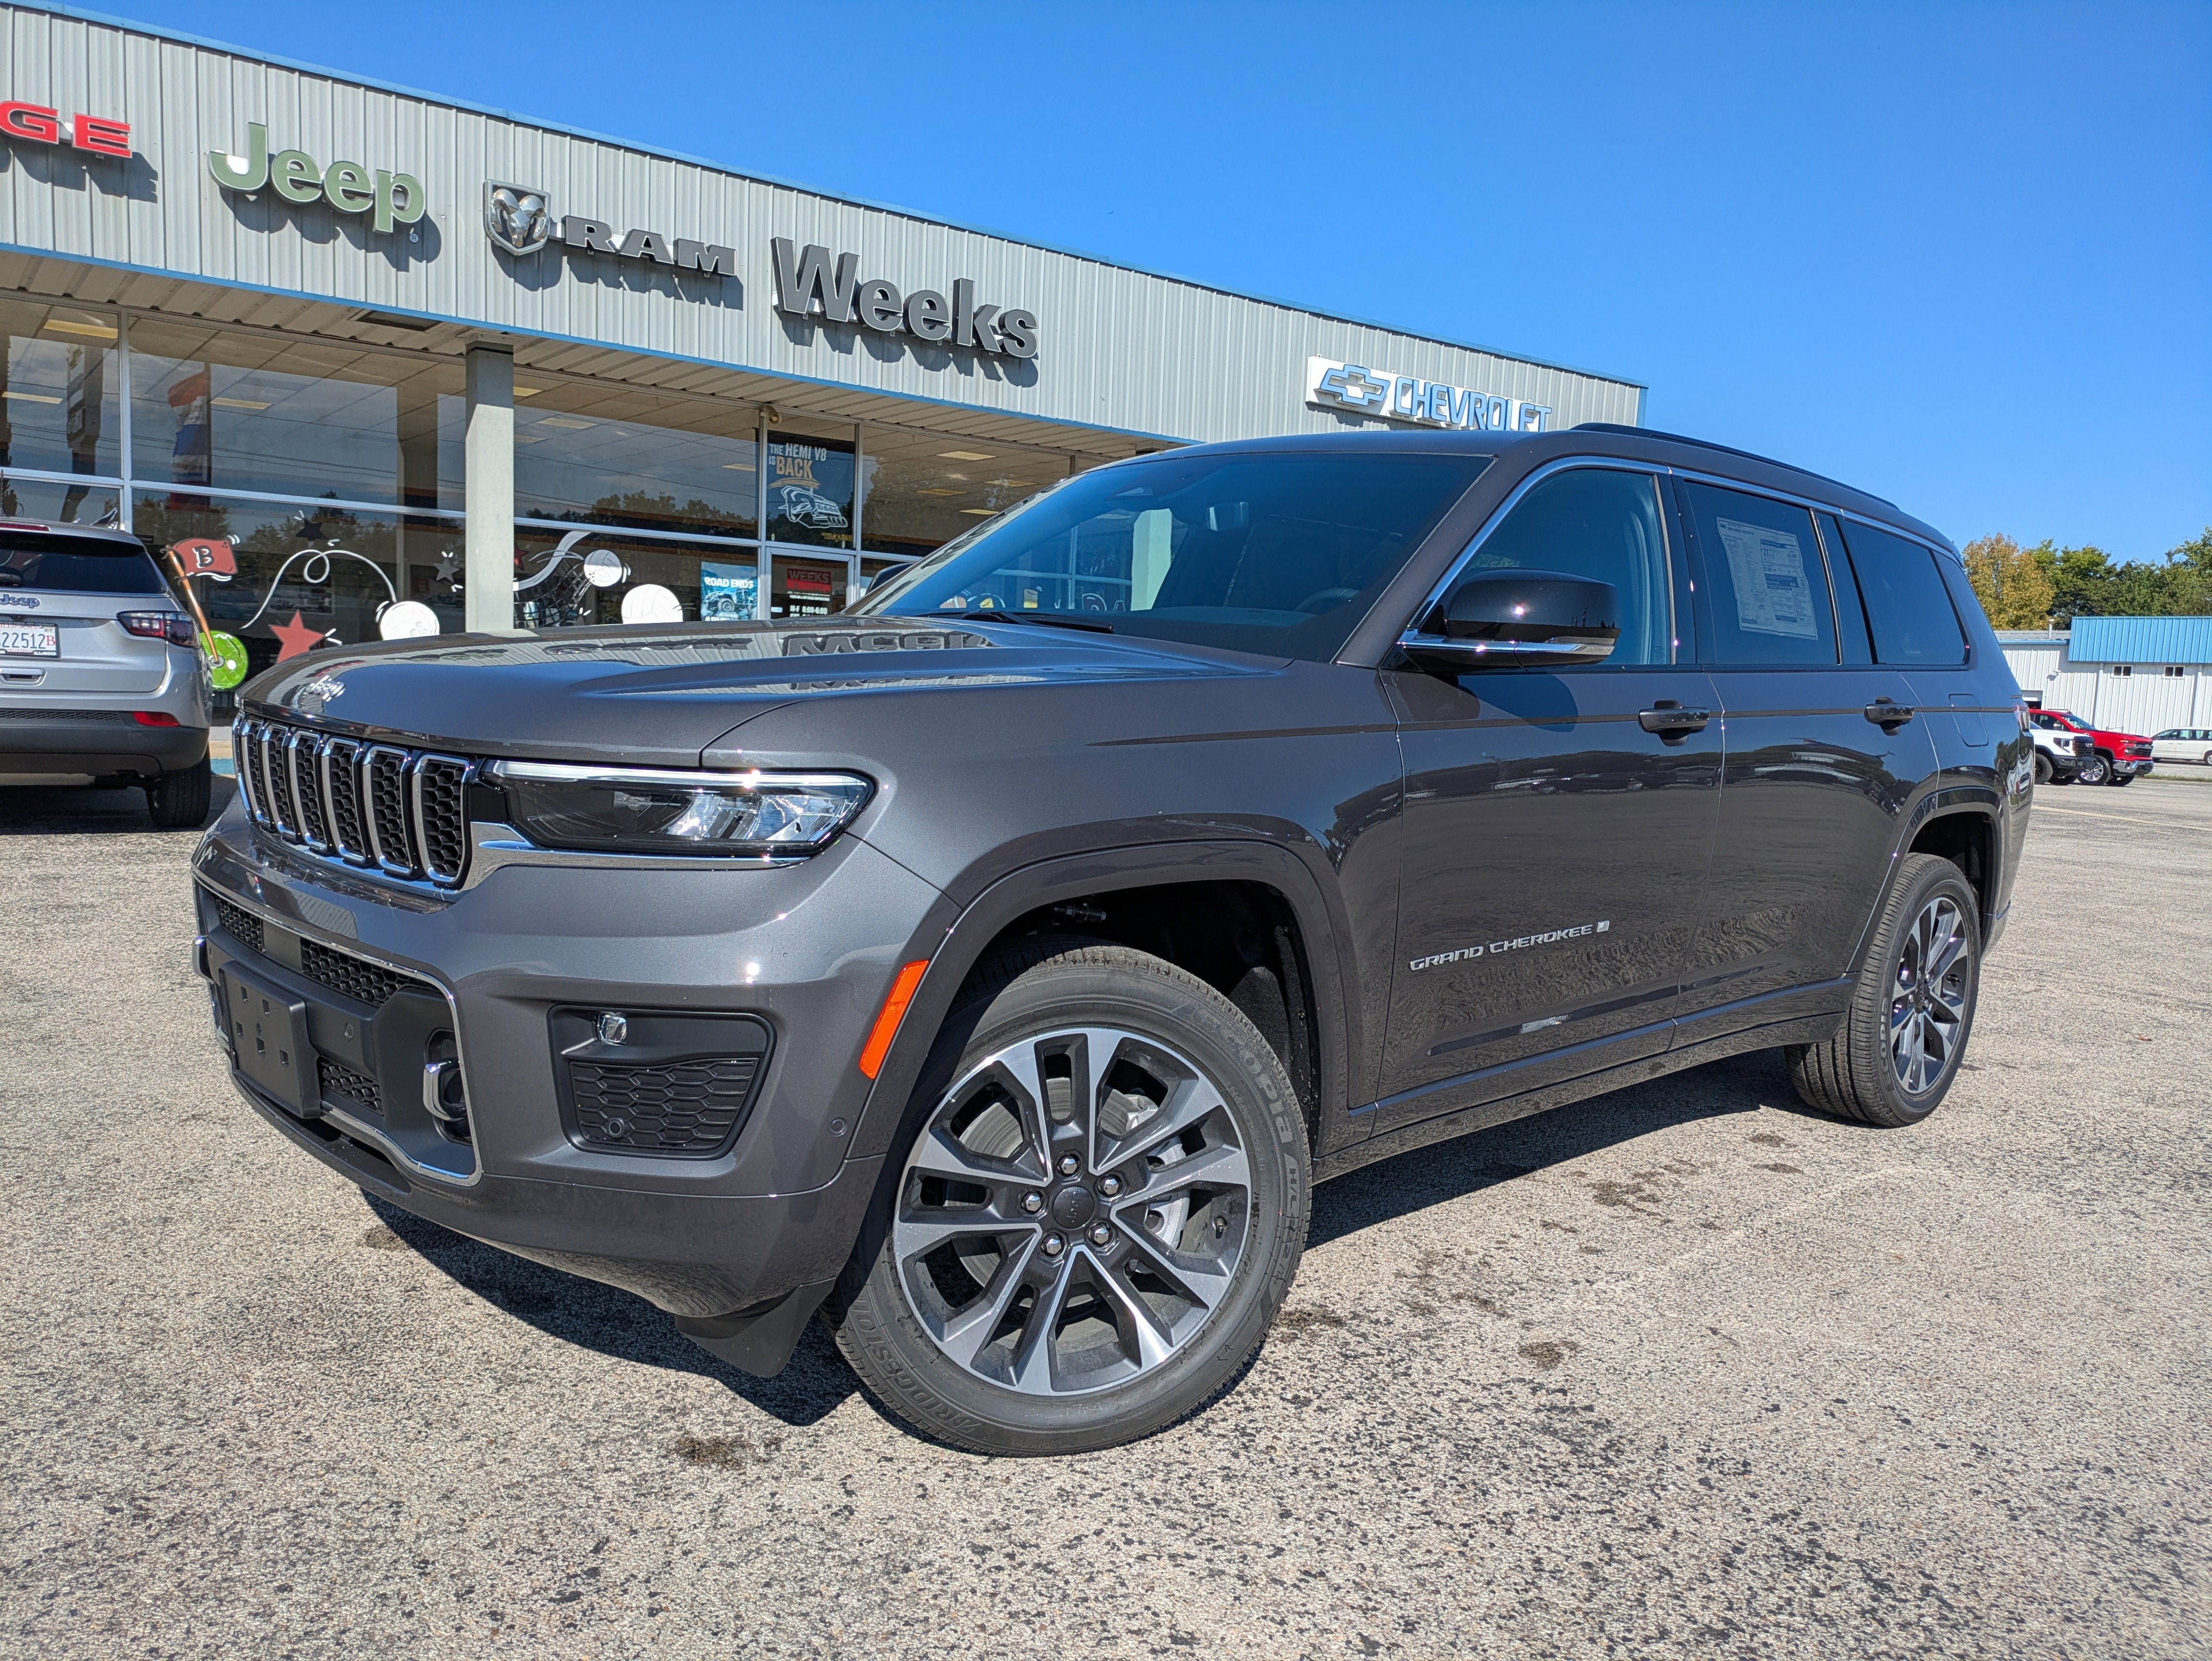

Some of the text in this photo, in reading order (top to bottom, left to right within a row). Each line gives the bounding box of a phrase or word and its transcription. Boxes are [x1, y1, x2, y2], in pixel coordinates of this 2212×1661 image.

[208, 122, 425, 234] Jeep
[562, 215, 737, 277] RAM
[771, 236, 1039, 358] Weeks
[1394, 376, 1552, 432] CHEVROLET
[769, 443, 827, 461] THE HEMI V8
[769, 455, 813, 478] IS BACK
[192, 545, 214, 568] B
[704, 576, 754, 589] ROAD ENDS
[789, 570, 830, 584] WEEKS
[0, 594, 40, 609] Jeep
[1408, 946, 1483, 971] GRAND
[1488, 924, 1593, 954] CHEROKEE
